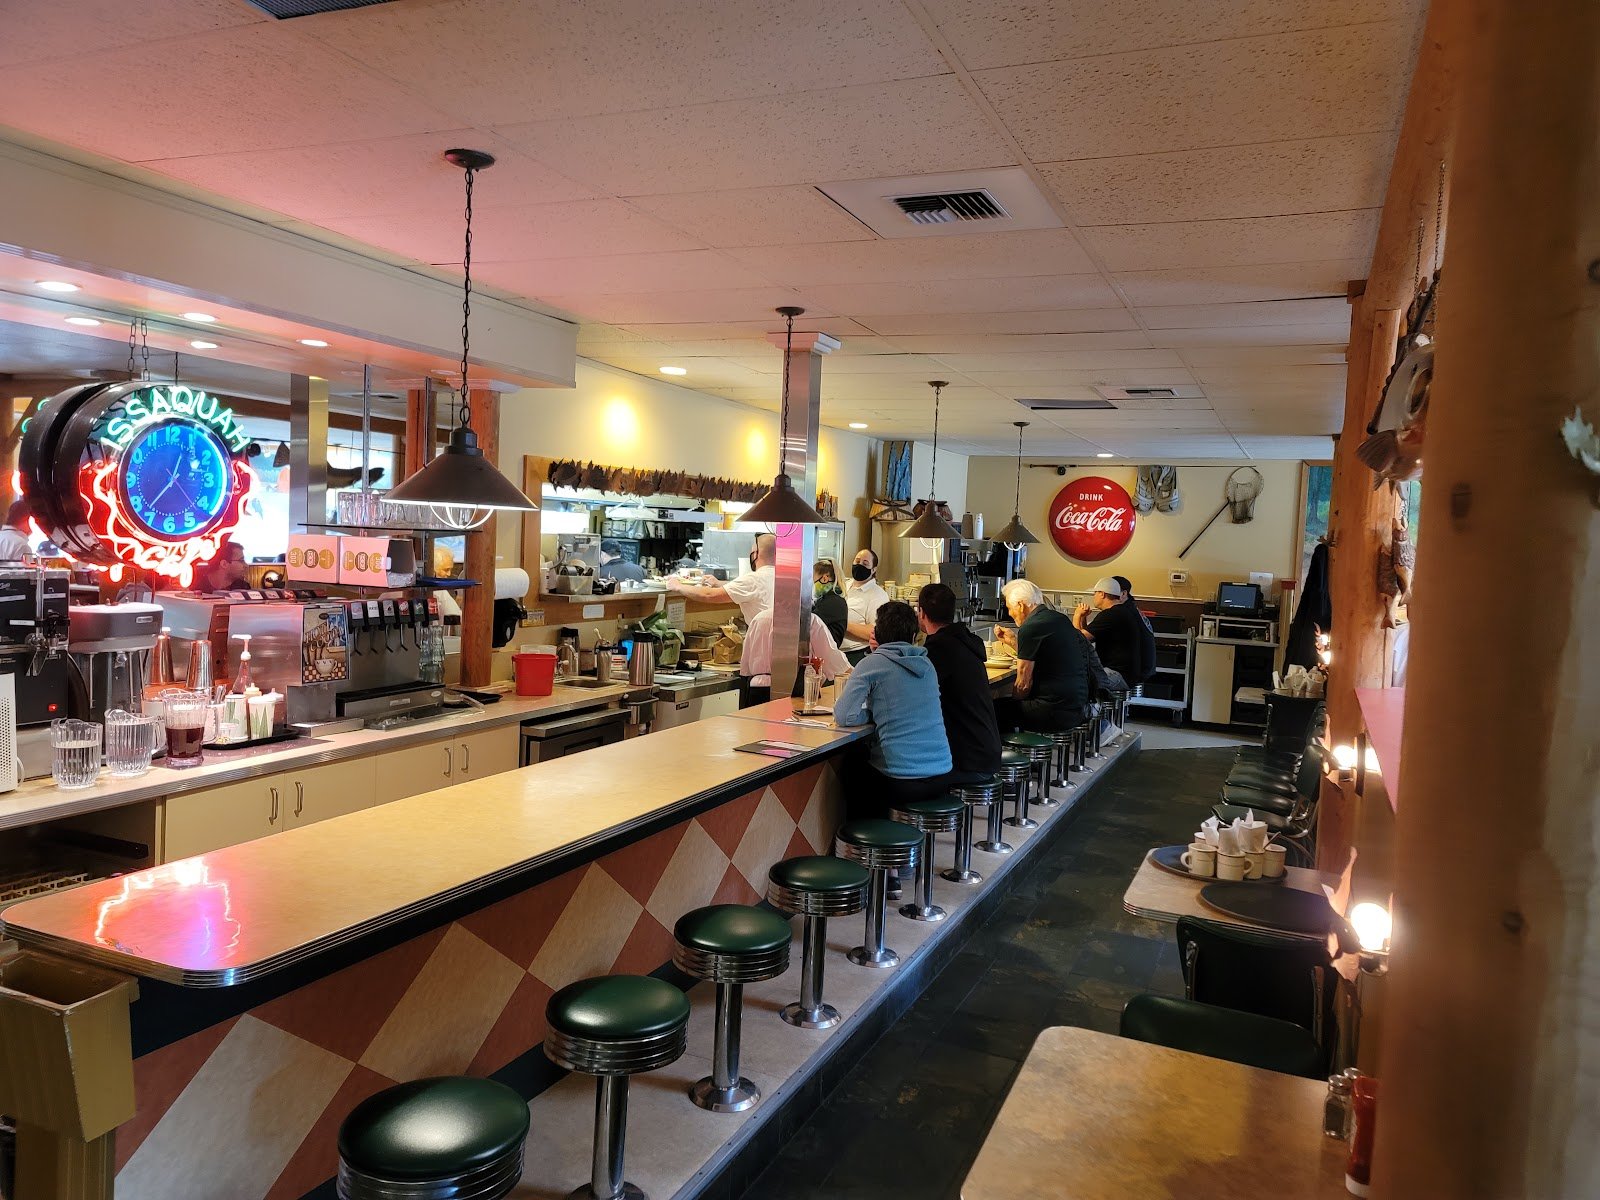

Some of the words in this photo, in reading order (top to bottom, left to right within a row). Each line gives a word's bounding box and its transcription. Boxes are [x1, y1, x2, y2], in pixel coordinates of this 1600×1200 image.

[101, 386, 250, 453] ISSAQUAH
[147, 431, 157, 447] 11
[166, 426, 181, 443] 12
[201, 450, 212, 466] 2
[126, 472, 137, 489] 9
[203, 472, 214, 488] 3
[130, 495, 143, 512] 8
[197, 495, 209, 511] 4
[1079, 493, 1104, 501] DRINK
[144, 511, 156, 527] 7
[163, 516, 175, 533] 6
[184, 511, 196, 528] 5
[1055, 505, 1127, 532] Coca-Cola
